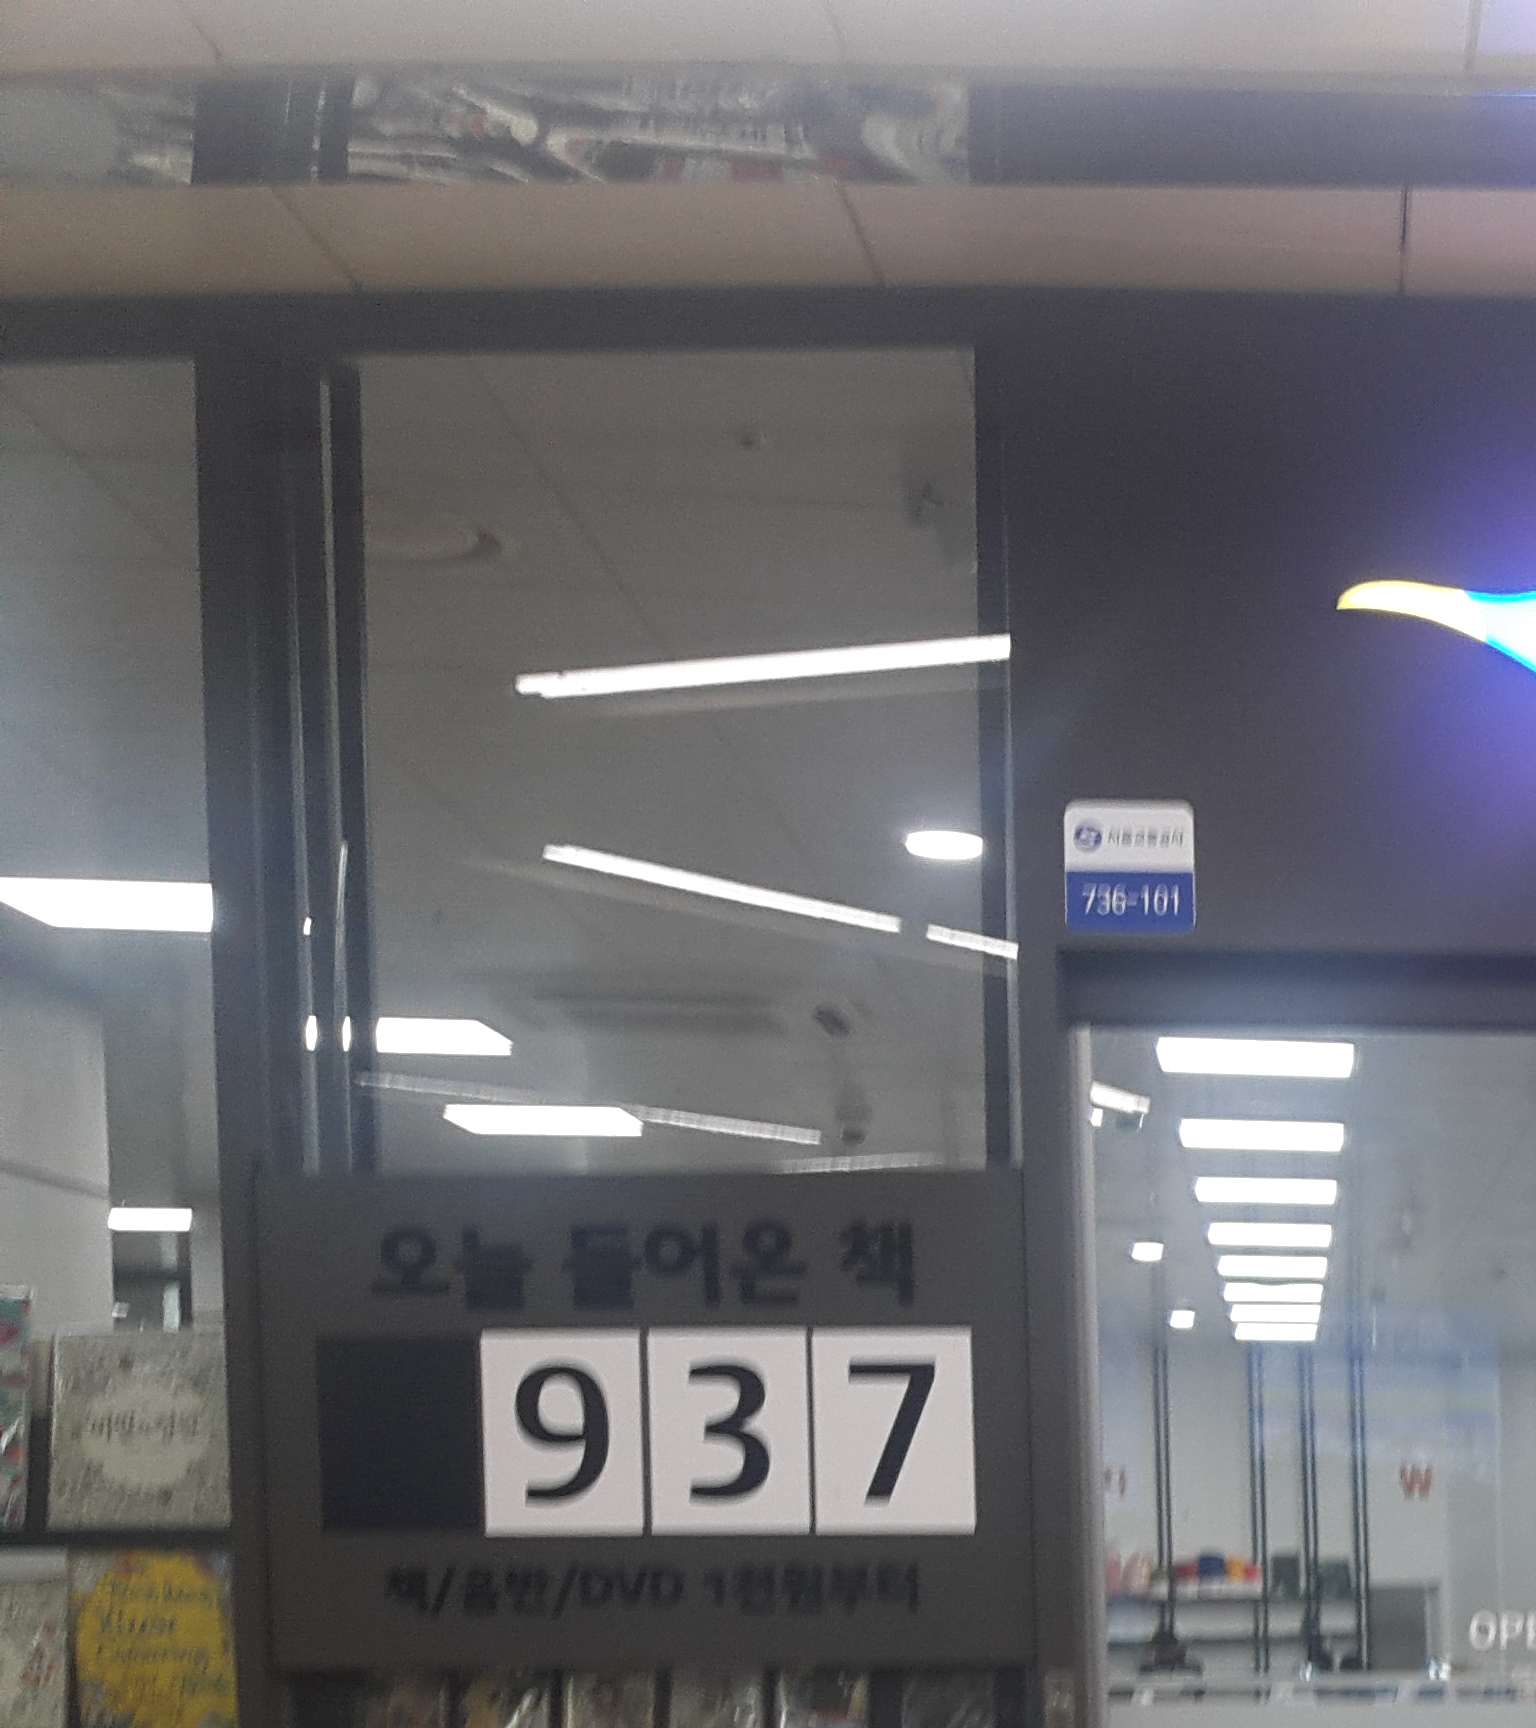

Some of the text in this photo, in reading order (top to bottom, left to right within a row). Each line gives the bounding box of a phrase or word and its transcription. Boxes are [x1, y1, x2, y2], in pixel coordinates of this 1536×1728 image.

[1082, 882, 1180, 917] 736-101
[369, 1218, 915, 1312] 오늘 들어온 책
